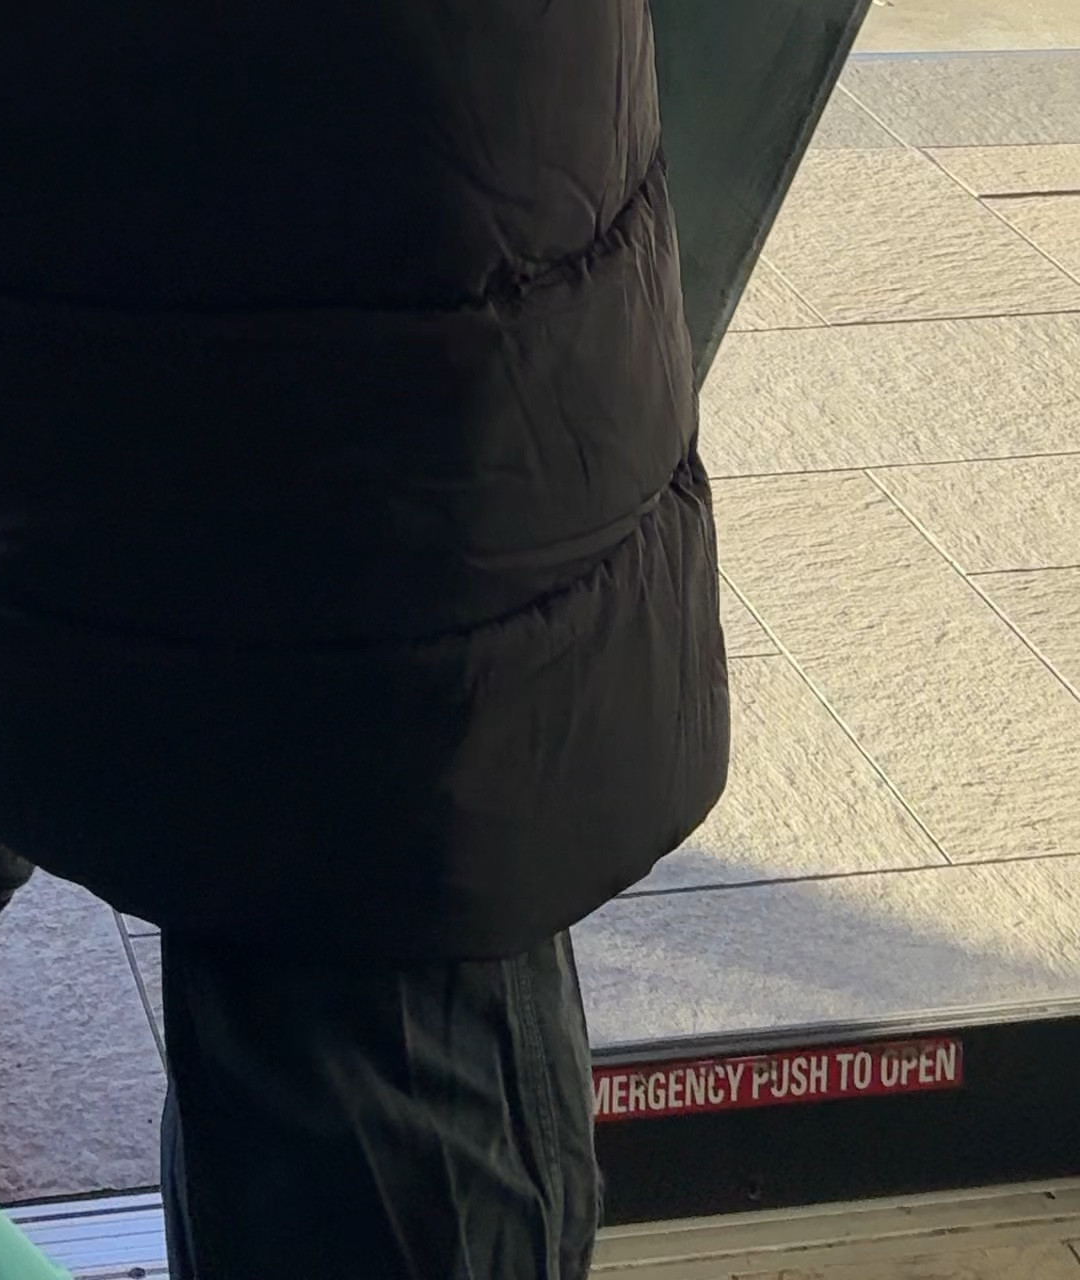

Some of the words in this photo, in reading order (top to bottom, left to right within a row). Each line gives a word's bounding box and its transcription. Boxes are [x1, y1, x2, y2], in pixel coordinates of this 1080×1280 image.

[592, 1062, 745, 1116] MERGENCY
[752, 1054, 829, 1100] PUSH
[836, 1051, 873, 1091] TO
[881, 1042, 957, 1088] OPEN
